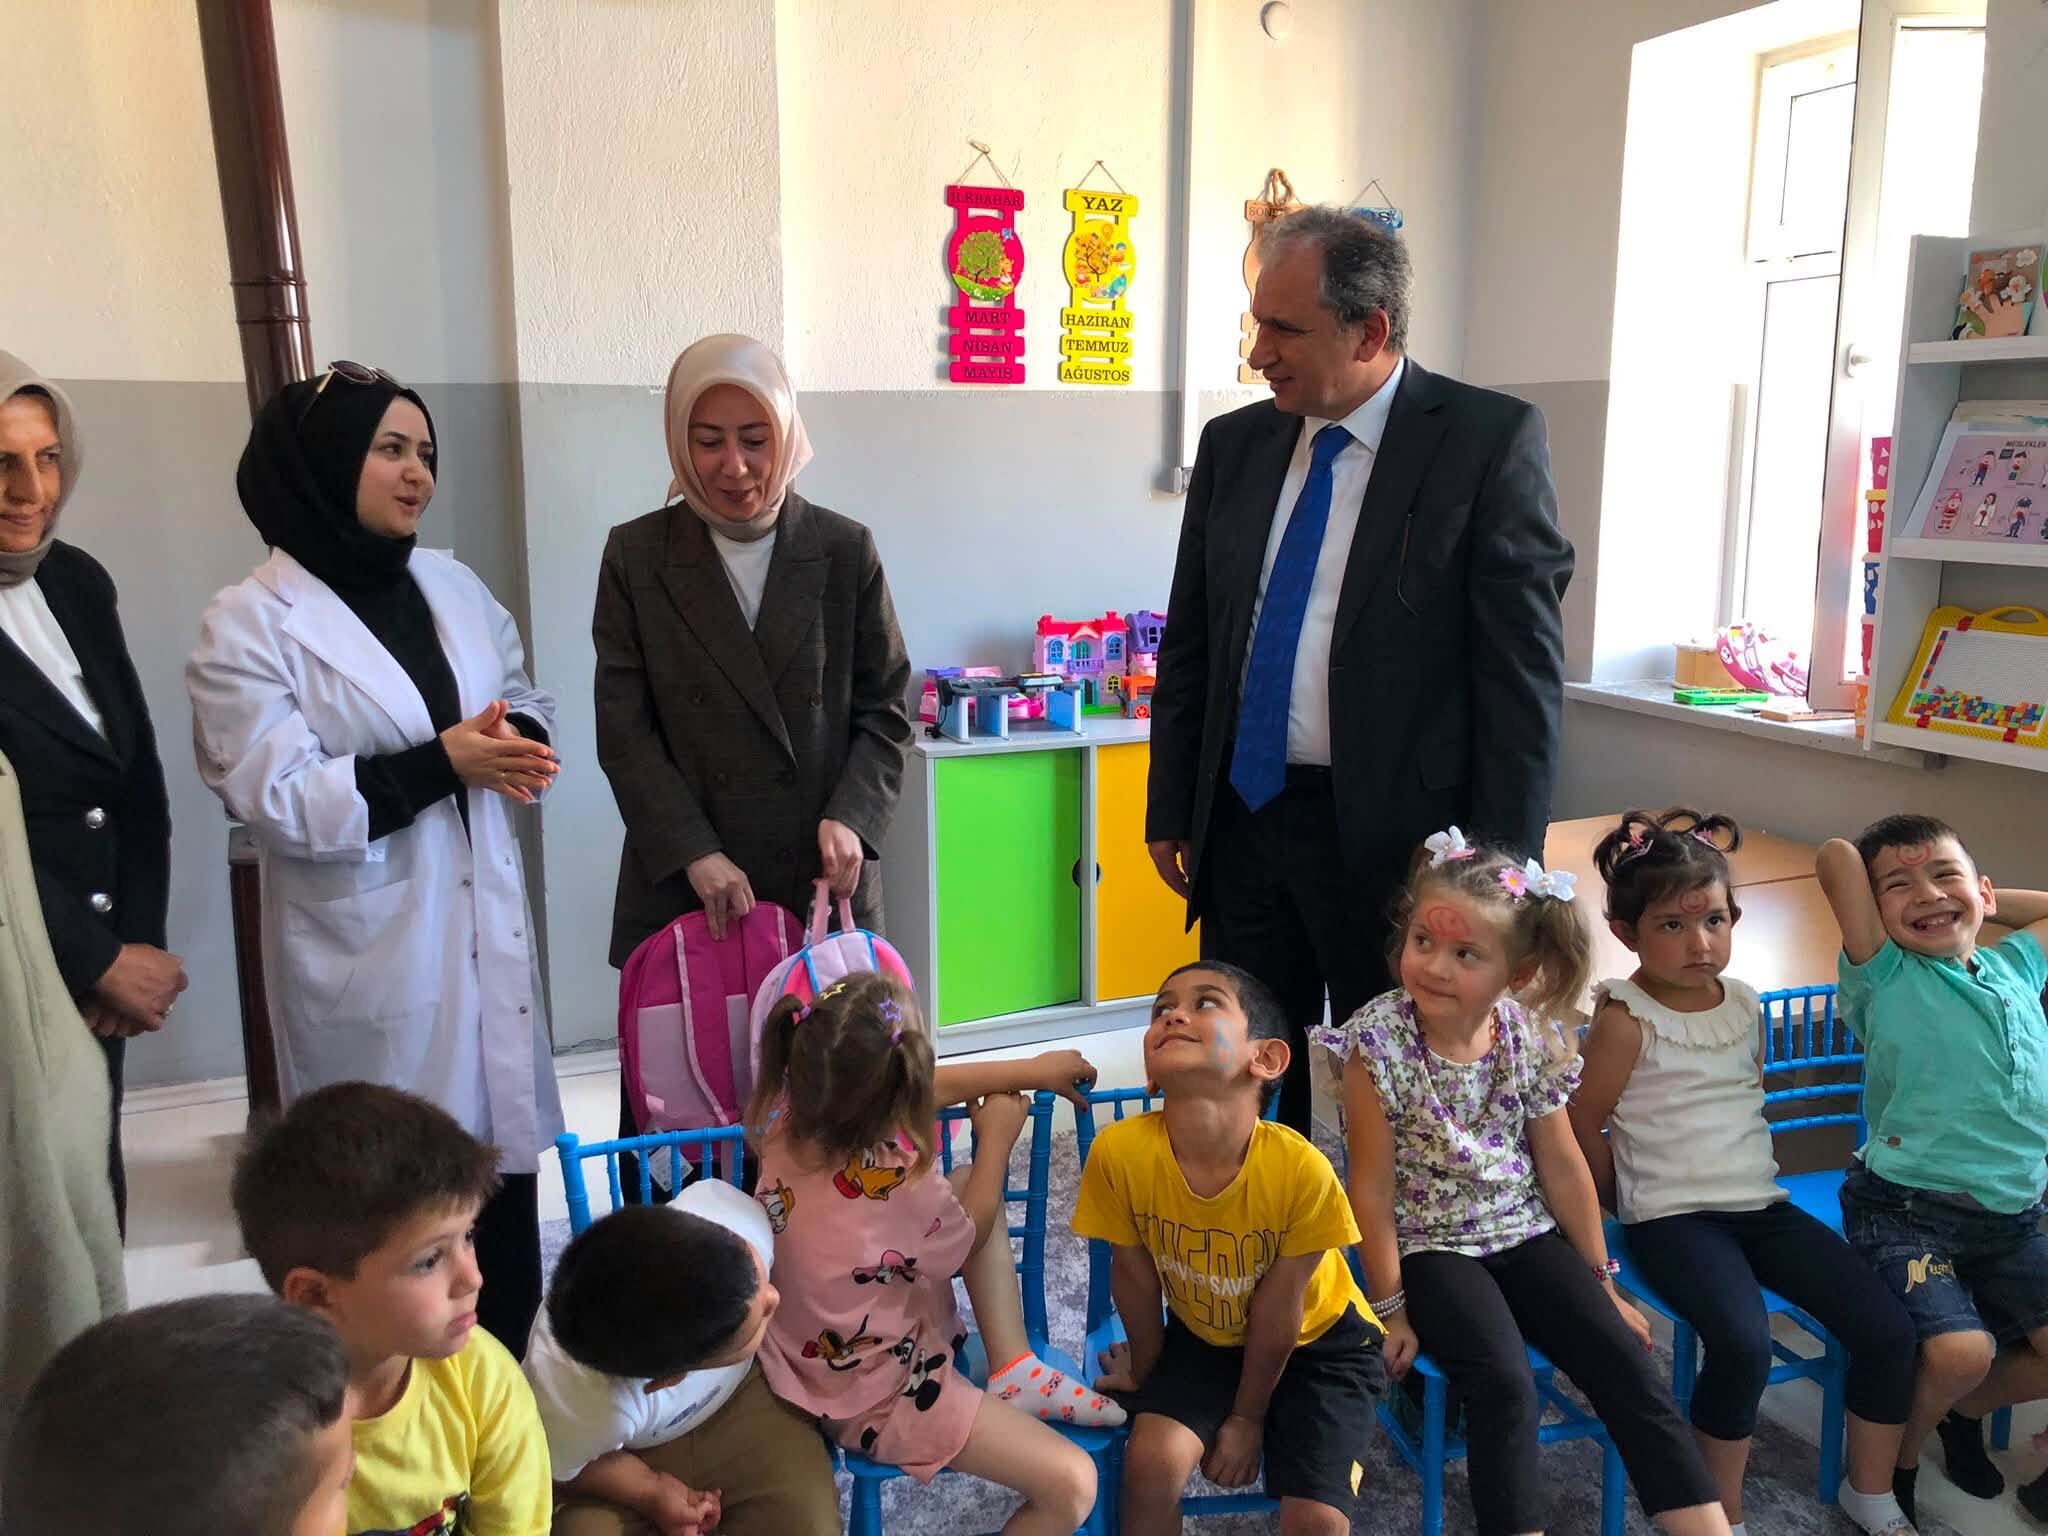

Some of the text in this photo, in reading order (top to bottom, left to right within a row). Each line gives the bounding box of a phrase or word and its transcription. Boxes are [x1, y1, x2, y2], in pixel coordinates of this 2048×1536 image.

[1081, 195, 1123, 212] YAZ
[964, 310, 1010, 324] MART
[1065, 312, 1130, 328] HAZİRAN
[1066, 338, 1129, 353] TEMMUZ
[964, 366, 1013, 379] MAYIS
[1063, 366, 1130, 382] AĞUSTOS
